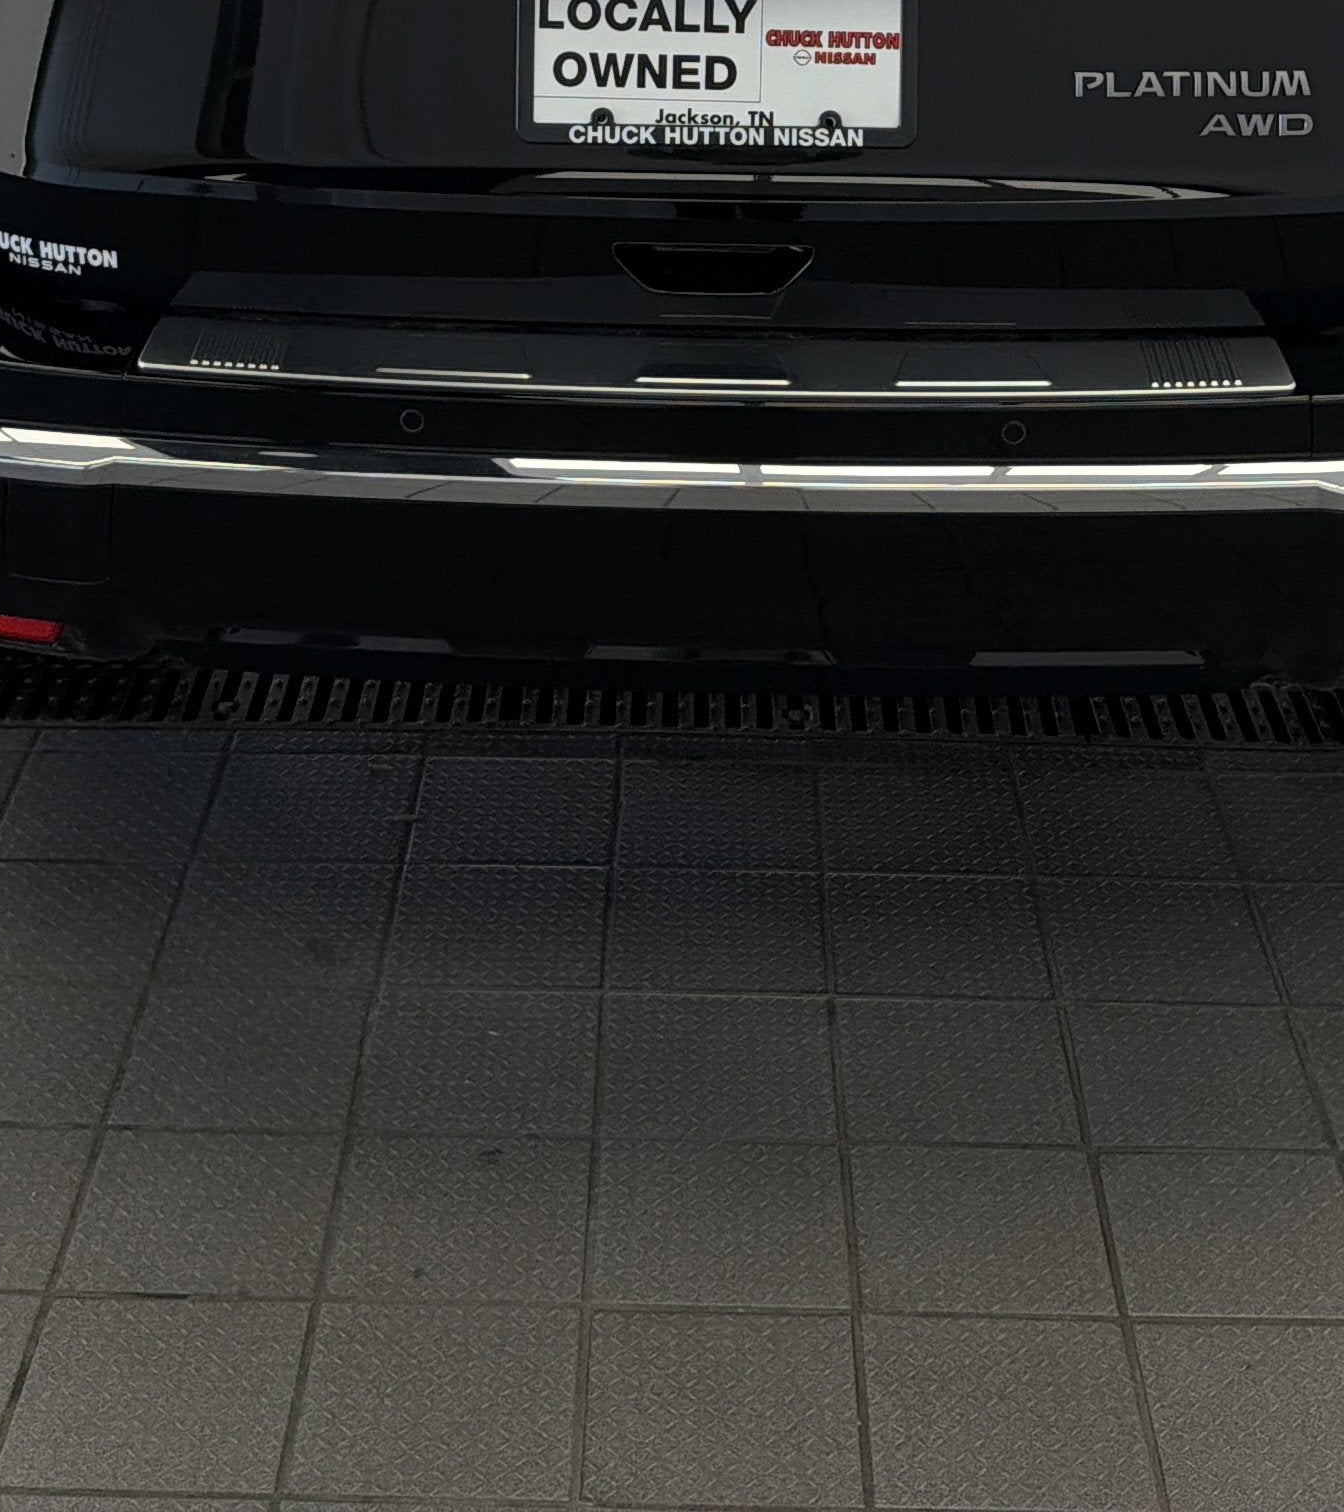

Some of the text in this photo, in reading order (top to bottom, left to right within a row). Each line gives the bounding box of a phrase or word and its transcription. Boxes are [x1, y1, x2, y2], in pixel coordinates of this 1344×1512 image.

[765, 28, 900, 50] CHUCK HUTTON
[552, 50, 738, 90] OWNED
[814, 51, 877, 65] NISSAN
[1073, 70, 1312, 98] PLATINUM
[654, 108, 775, 127] Jackson, TN
[1199, 113, 1314, 136] AWD
[568, 123, 864, 147] CHUCK HUTTON NISSAN
[8, 252, 82, 276] NISSAN
[39, 240, 119, 269] HUTTON
